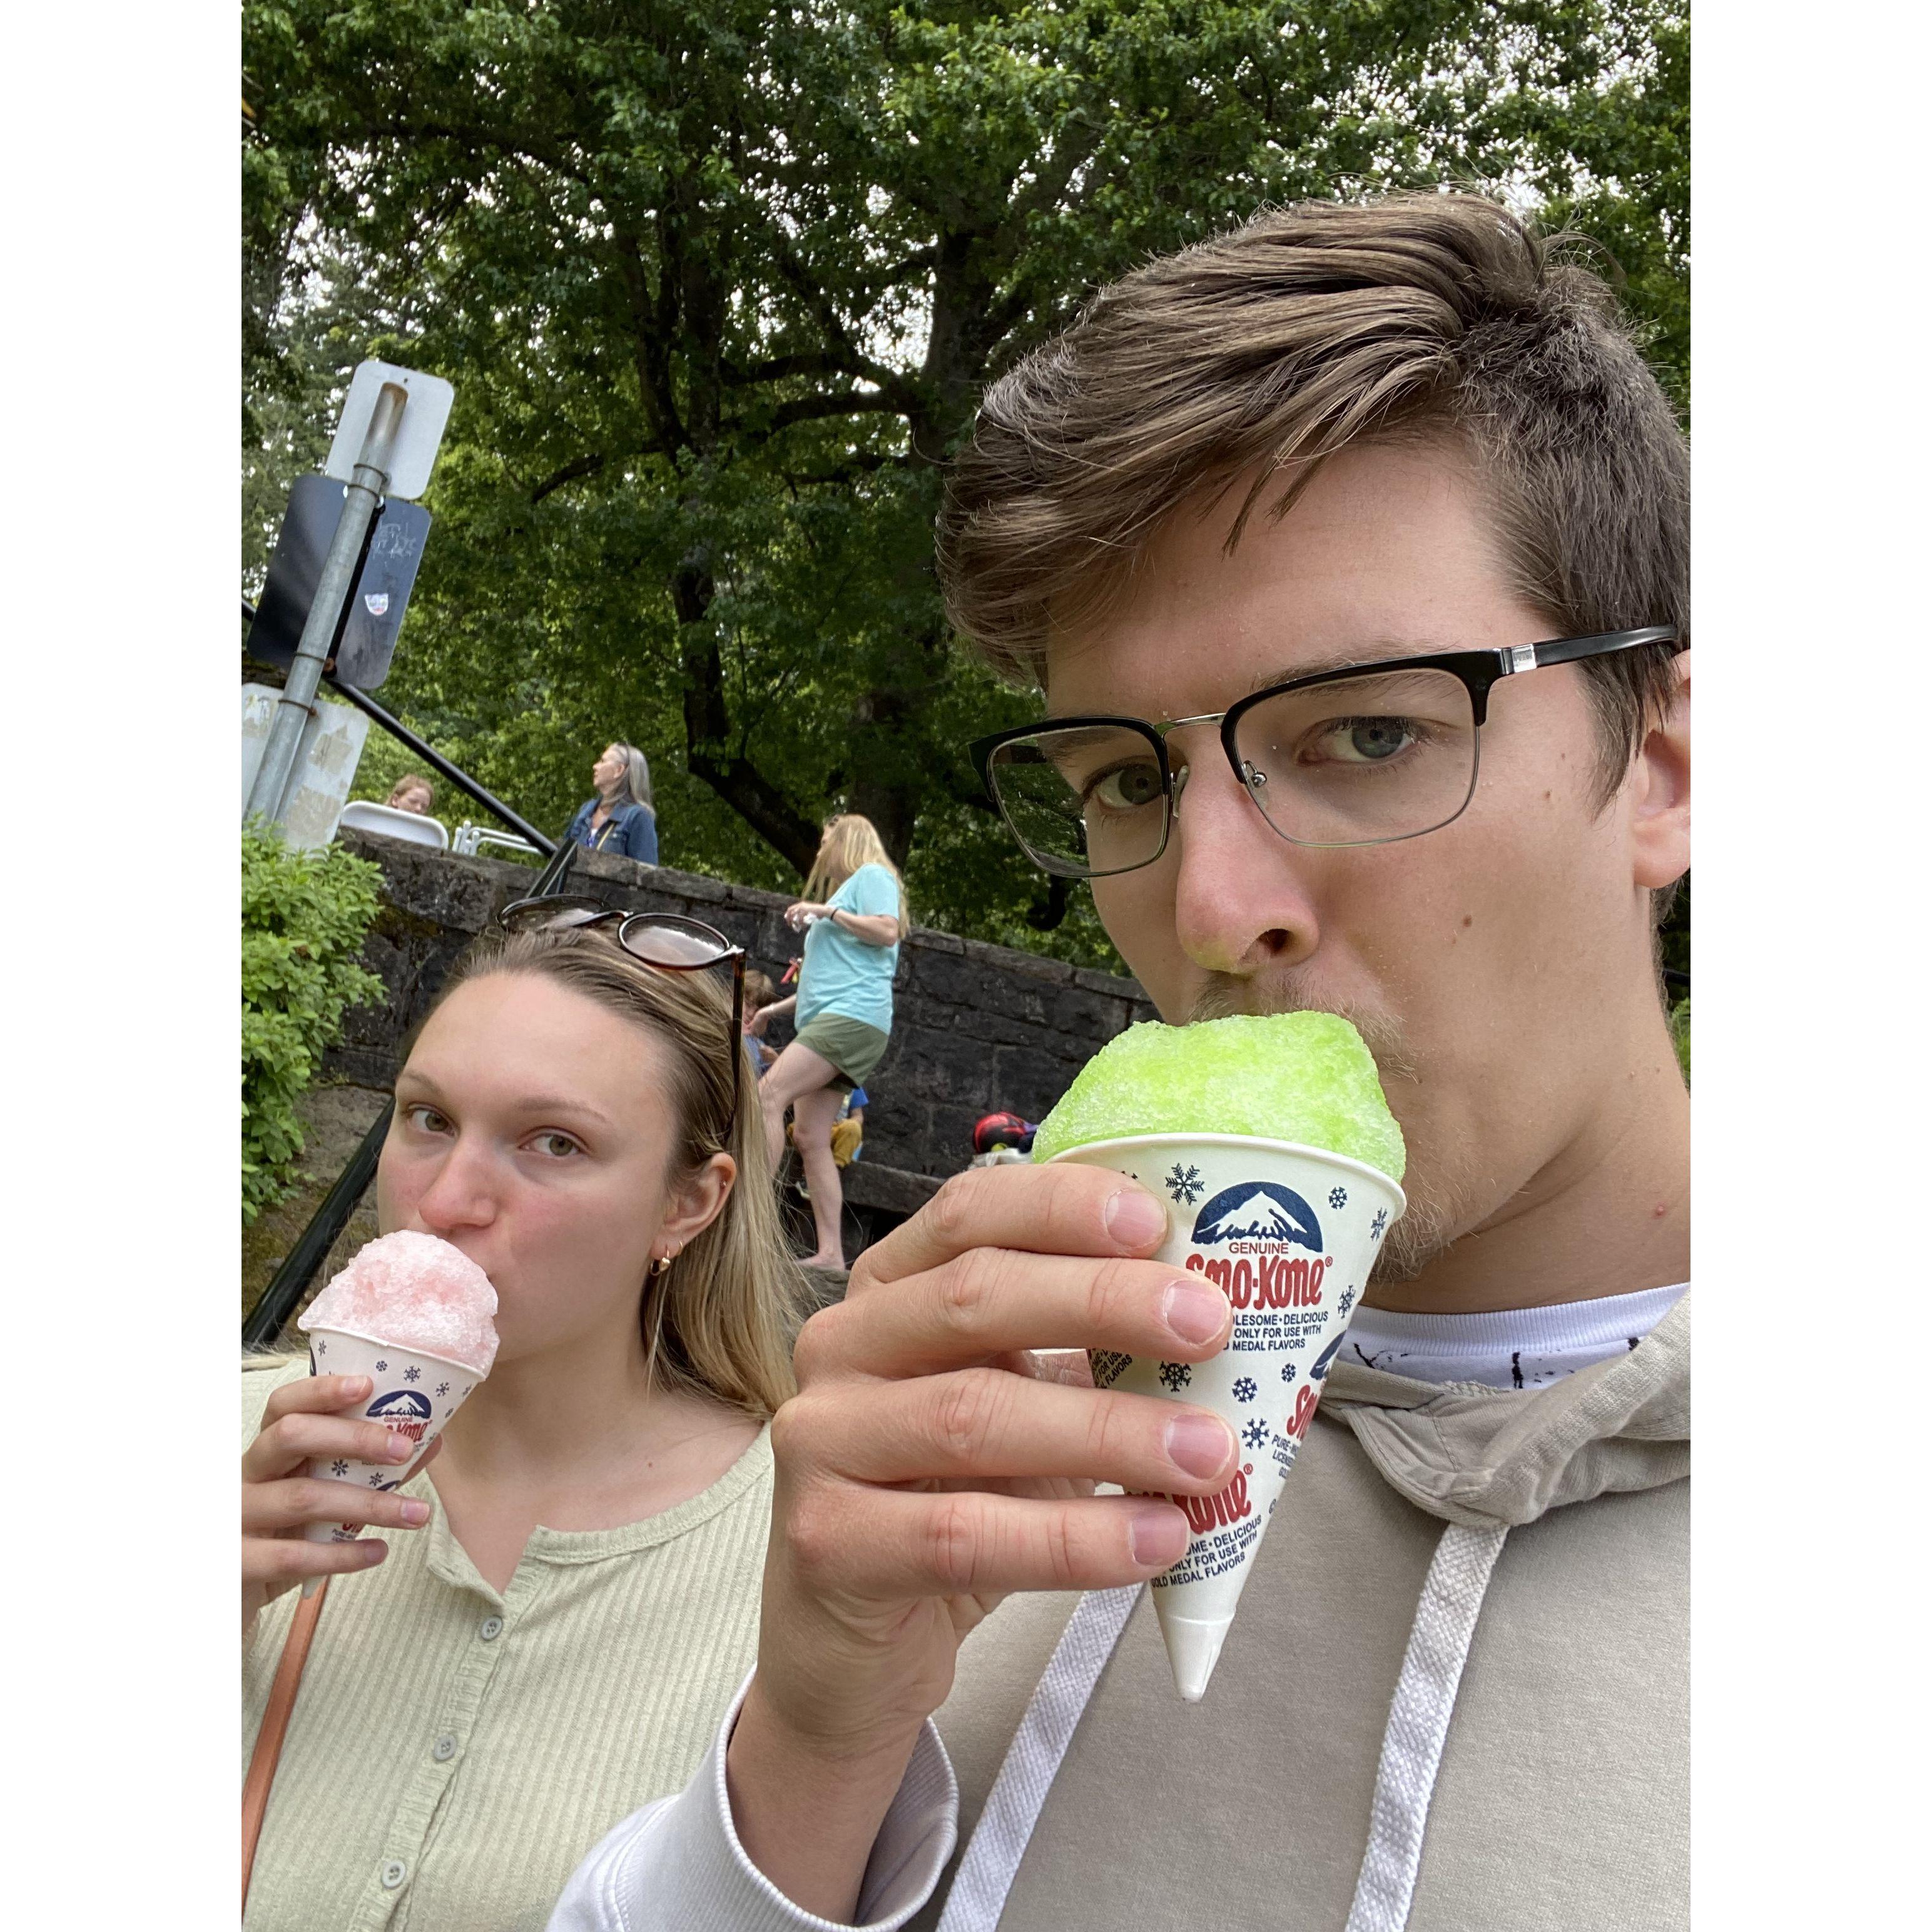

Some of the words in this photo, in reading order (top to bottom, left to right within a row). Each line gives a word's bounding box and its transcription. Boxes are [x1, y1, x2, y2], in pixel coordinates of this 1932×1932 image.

[1229, 1242, 1289, 1254] GENUINE
[1233, 1314, 1278, 1326] LESOME
[1284, 1311, 1329, 1325] DELICIOUS
[1234, 1328, 1260, 1338] ONLY
[1263, 1327, 1282, 1338] FOR
[1284, 1326, 1300, 1338] USE
[1303, 1324, 1321, 1336] WITH
[1233, 1340, 1266, 1351] MEDAL
[1268, 1338, 1306, 1350] FLAVORS
[1105, 1354, 1132, 1385] FLAVORS
[1213, 1514, 1262, 1548] DELICIOUS
[1194, 1553, 1217, 1568] FOR
[1219, 1543, 1238, 1560] USE
[1239, 1530, 1258, 1550] WITH
[1171, 1572, 1204, 1586] MEDAL
[1204, 1551, 1246, 1579] FLAVORS
